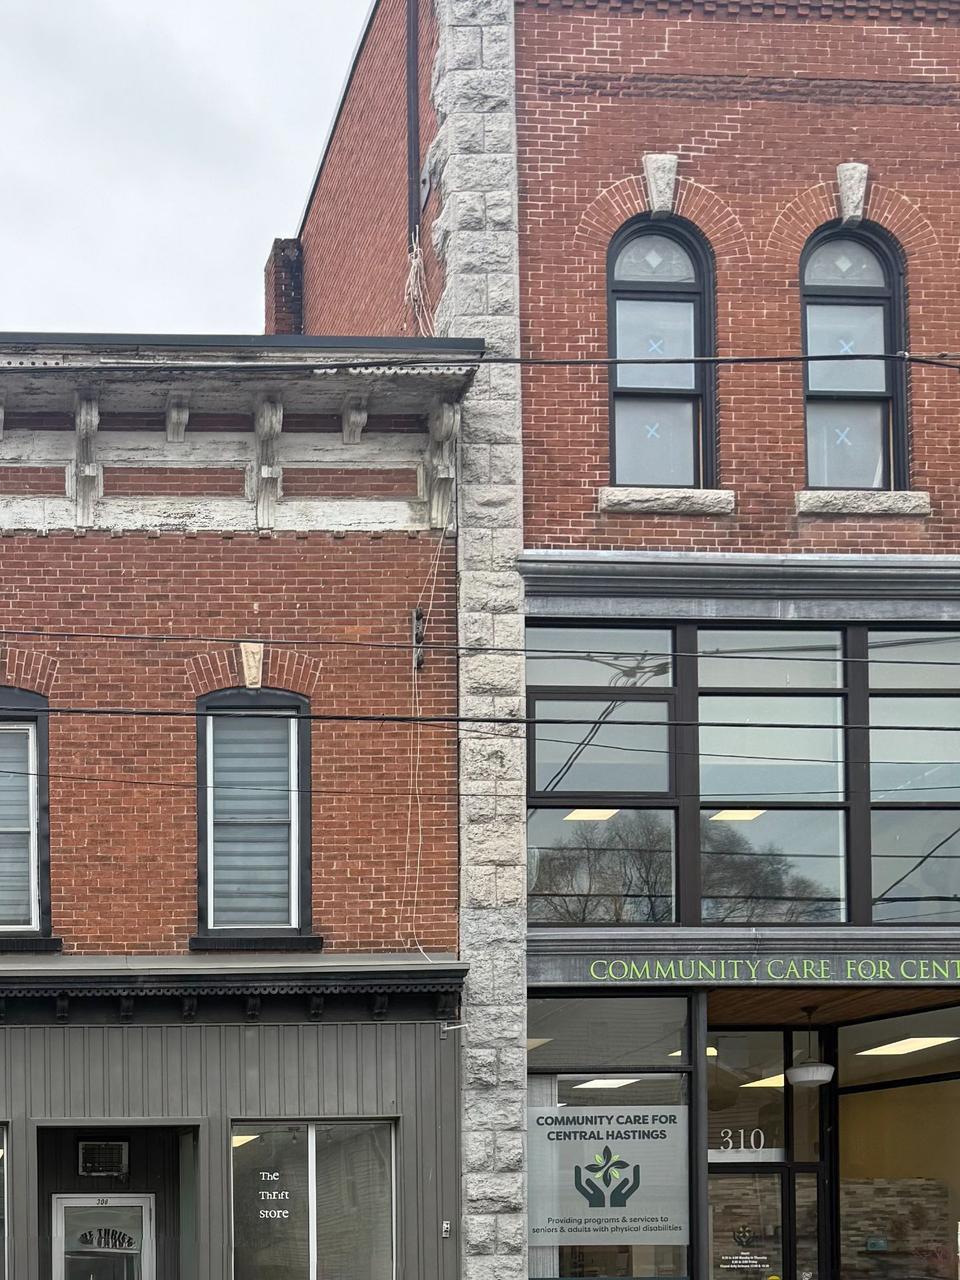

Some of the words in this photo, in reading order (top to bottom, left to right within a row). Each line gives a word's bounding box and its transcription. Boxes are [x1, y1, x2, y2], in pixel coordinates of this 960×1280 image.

[590, 959, 761, 980] COMMUNITY
[767, 959, 831, 979] CARE
[846, 959, 895, 979] FOR
[536, 1115, 614, 1126] COMMUNITY
[616, 1115, 649, 1125] CARE
[651, 1114, 677, 1124] FOR
[547, 1131, 603, 1141] CENTRAL
[606, 1130, 667, 1140] HASTINGS
[720, 1128, 765, 1151] 310
[259, 1171, 280, 1181] The
[258, 1190, 290, 1200] Thrift
[547, 1217, 582, 1225] Providing
[584, 1217, 619, 1225] programs
[610, 1225, 640, 1233] physical
